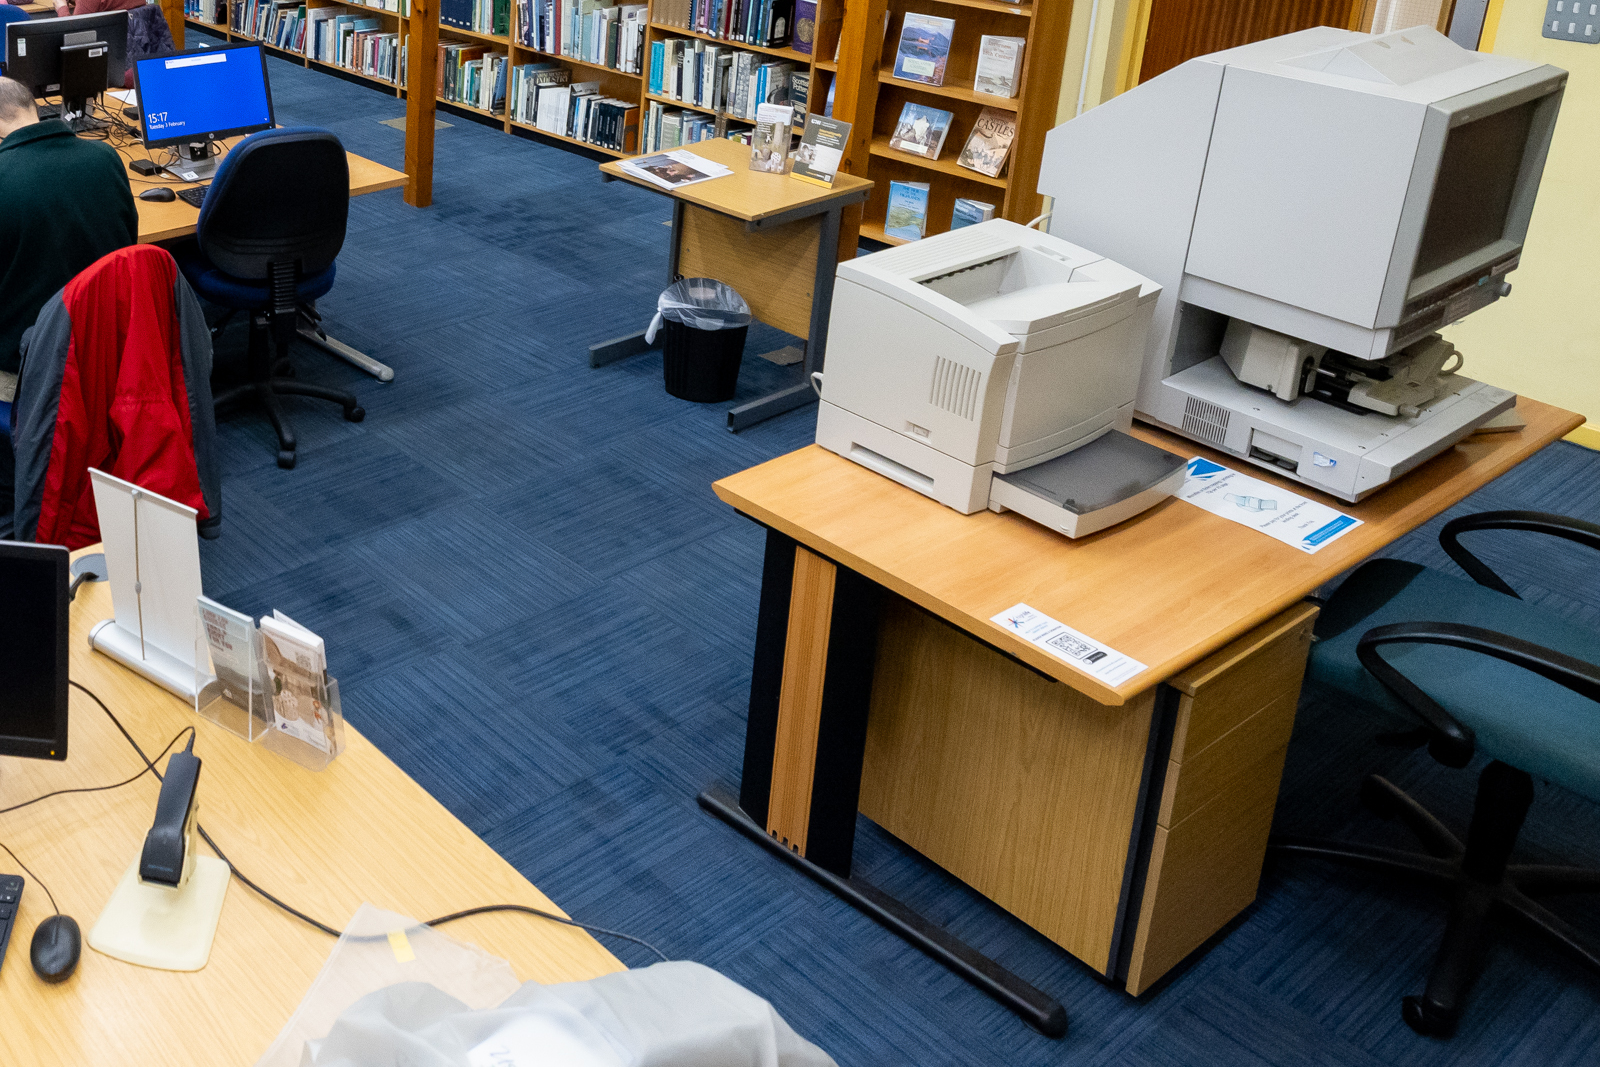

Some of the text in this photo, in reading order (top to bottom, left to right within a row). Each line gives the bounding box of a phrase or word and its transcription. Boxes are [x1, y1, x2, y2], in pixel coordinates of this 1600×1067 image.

[147, 111, 168, 124] 15:17
[168, 120, 186, 128] February
[977, 118, 1015, 137] CASTLES
